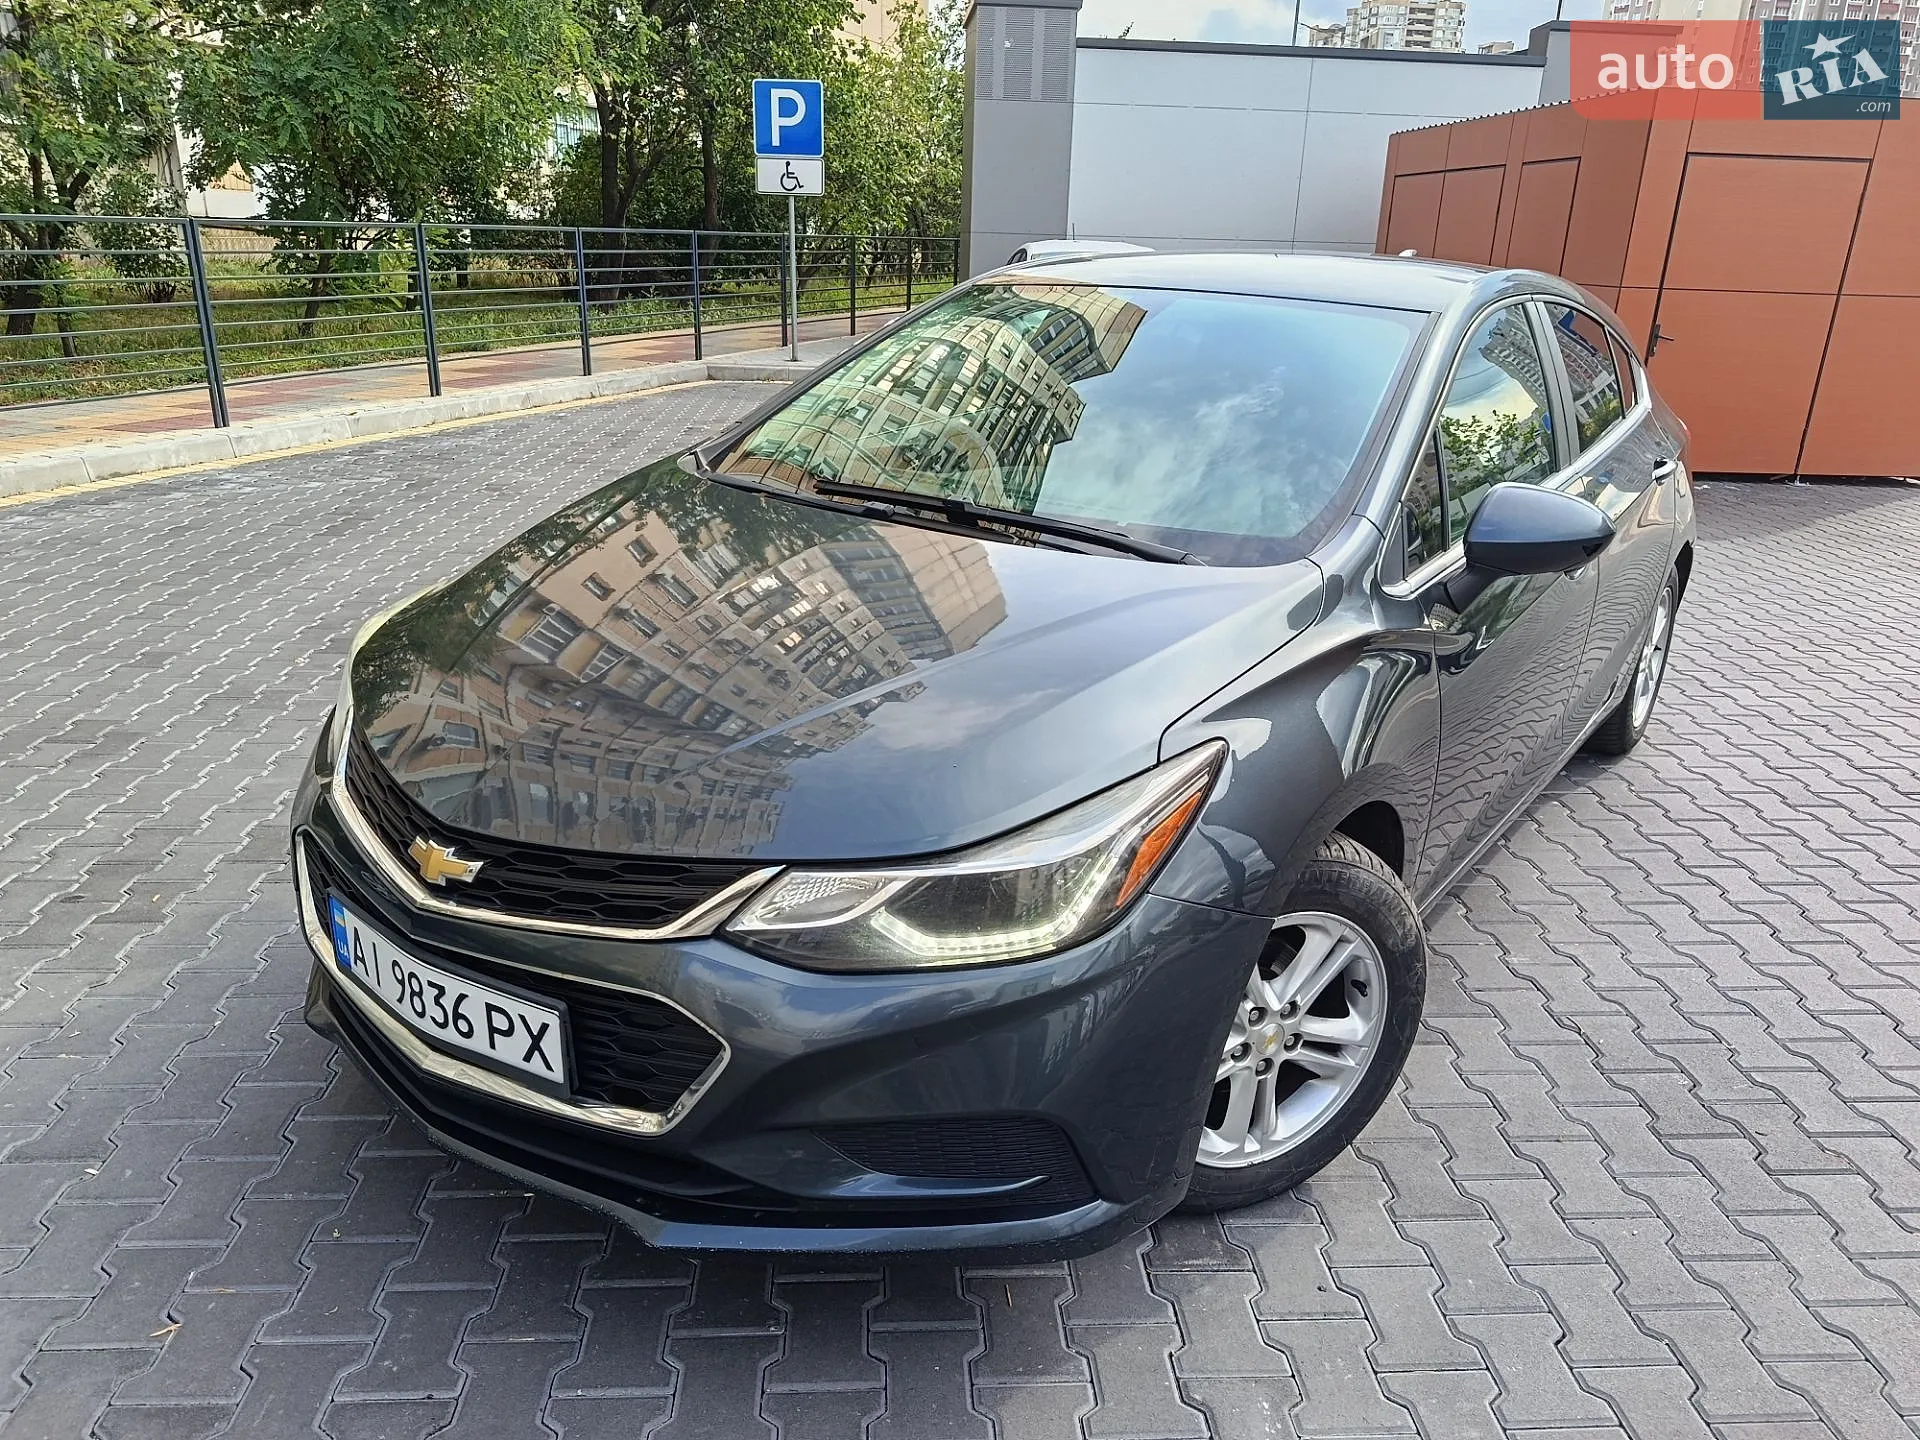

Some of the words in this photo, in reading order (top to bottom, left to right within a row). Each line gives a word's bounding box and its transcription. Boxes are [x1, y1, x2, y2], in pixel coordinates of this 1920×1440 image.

[770, 87, 806, 147] P
[353, 926, 381, 988] AI
[391, 959, 474, 1040] 9836
[484, 1001, 555, 1073] PX
